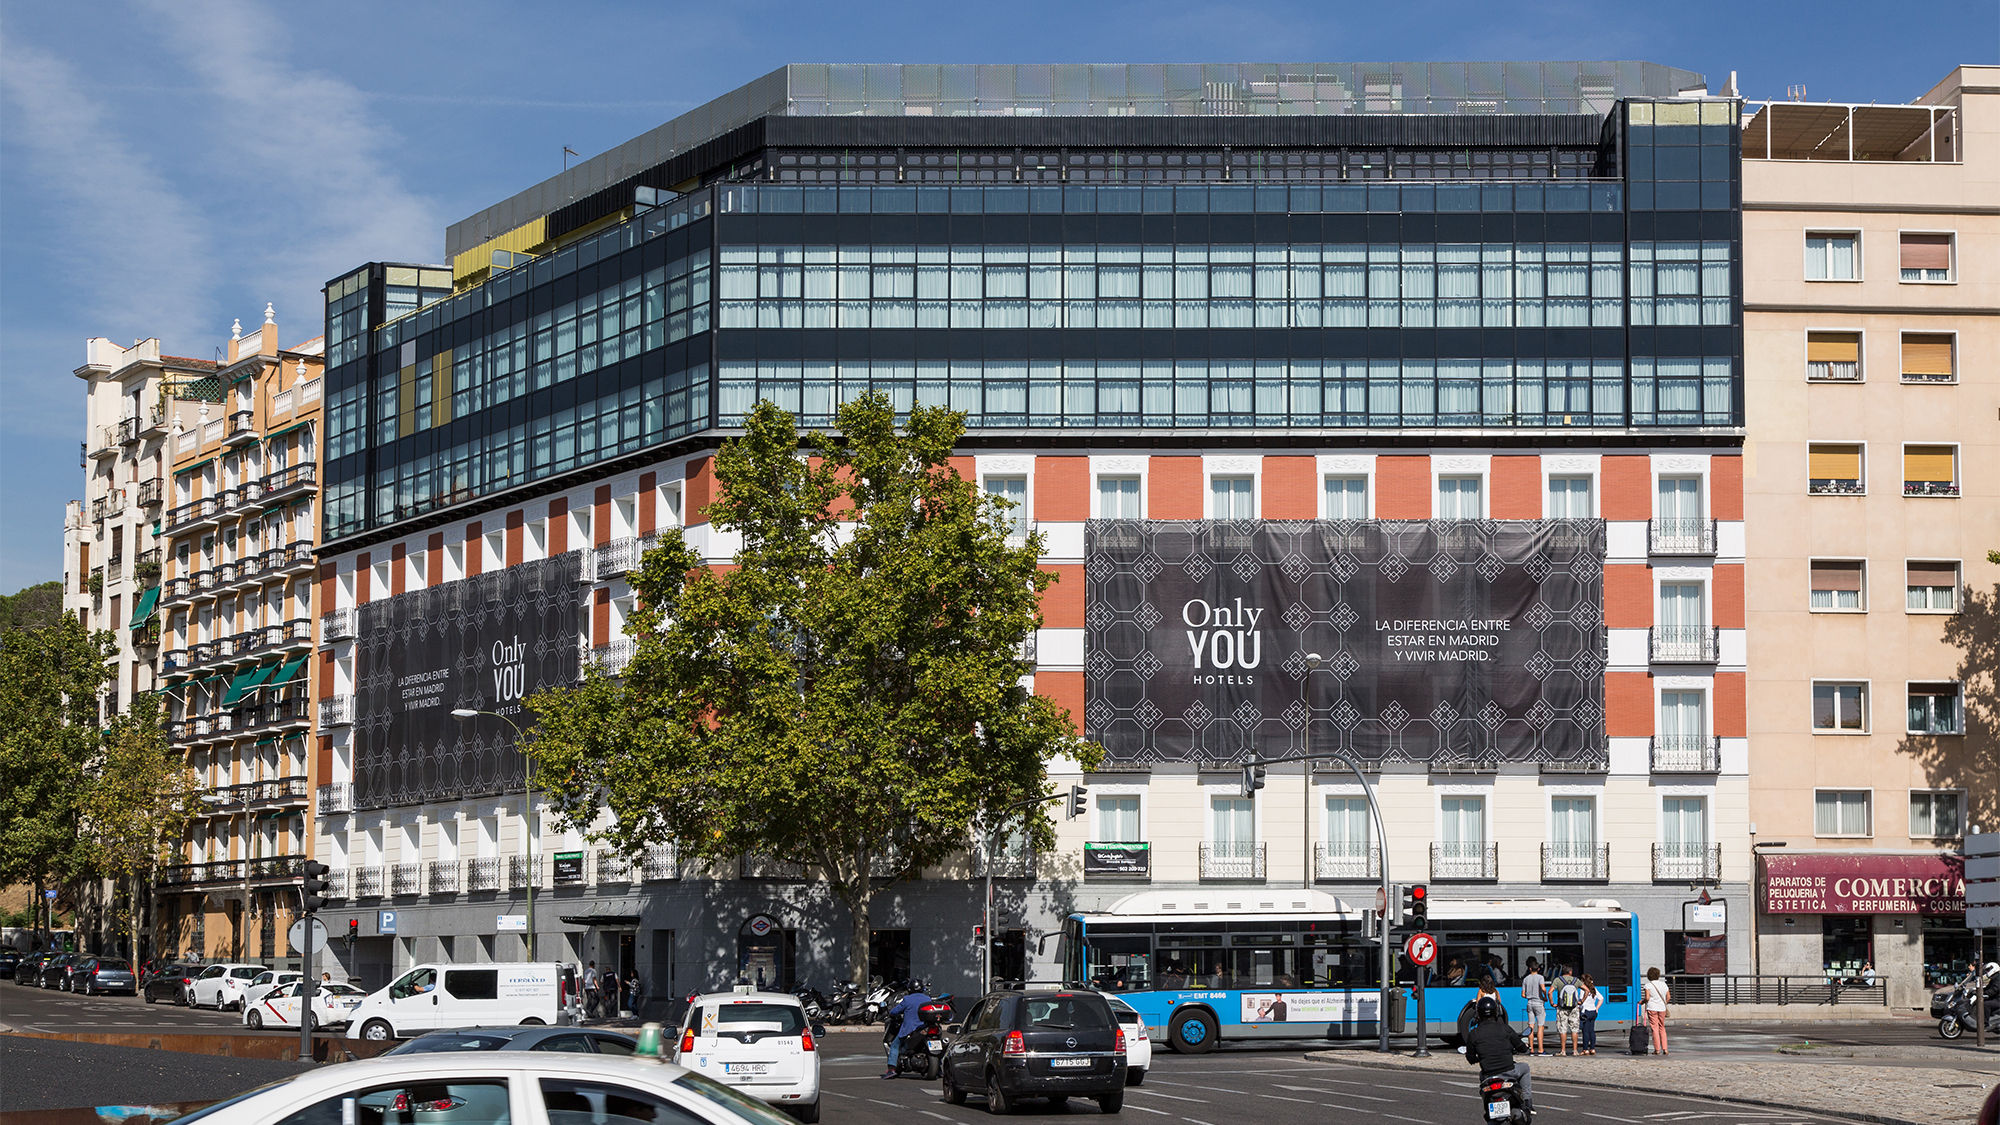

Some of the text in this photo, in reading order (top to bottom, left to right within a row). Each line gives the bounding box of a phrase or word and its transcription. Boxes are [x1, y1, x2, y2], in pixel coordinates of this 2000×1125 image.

[1182, 597, 1265, 637] Only
[1375, 620, 1511, 631] LA DIFERENCIA ENTRE
[1387, 635, 1500, 646] ESTAR EN MADRID
[492, 634, 527, 670] Only
[1186, 630, 1261, 669] YOU
[1394, 650, 1492, 661] Y VIVIR MADRID.
[397, 677, 405, 687] LA
[432, 668, 450, 680] ENTRE
[493, 663, 525, 703] YOU
[1193, 674, 1254, 685] HOTELS
[416, 686, 424, 697] EN
[495, 704, 522, 716] HOTELS
[1769, 877, 1826, 887] APARATOS DE
[1769, 888, 1827, 899] PELUQUERIA Y
[1834, 878, 1966, 898] COMERCIA
[1769, 900, 1827, 910] ESTETICA
[1852, 900, 1917, 911] PERFUMERIA
[1930, 900, 1966, 911] COSME
[382, 912, 394, 927] P
[1193, 992, 1209, 1000] EMT
[730, 1063, 767, 1072] 4694 HRC
